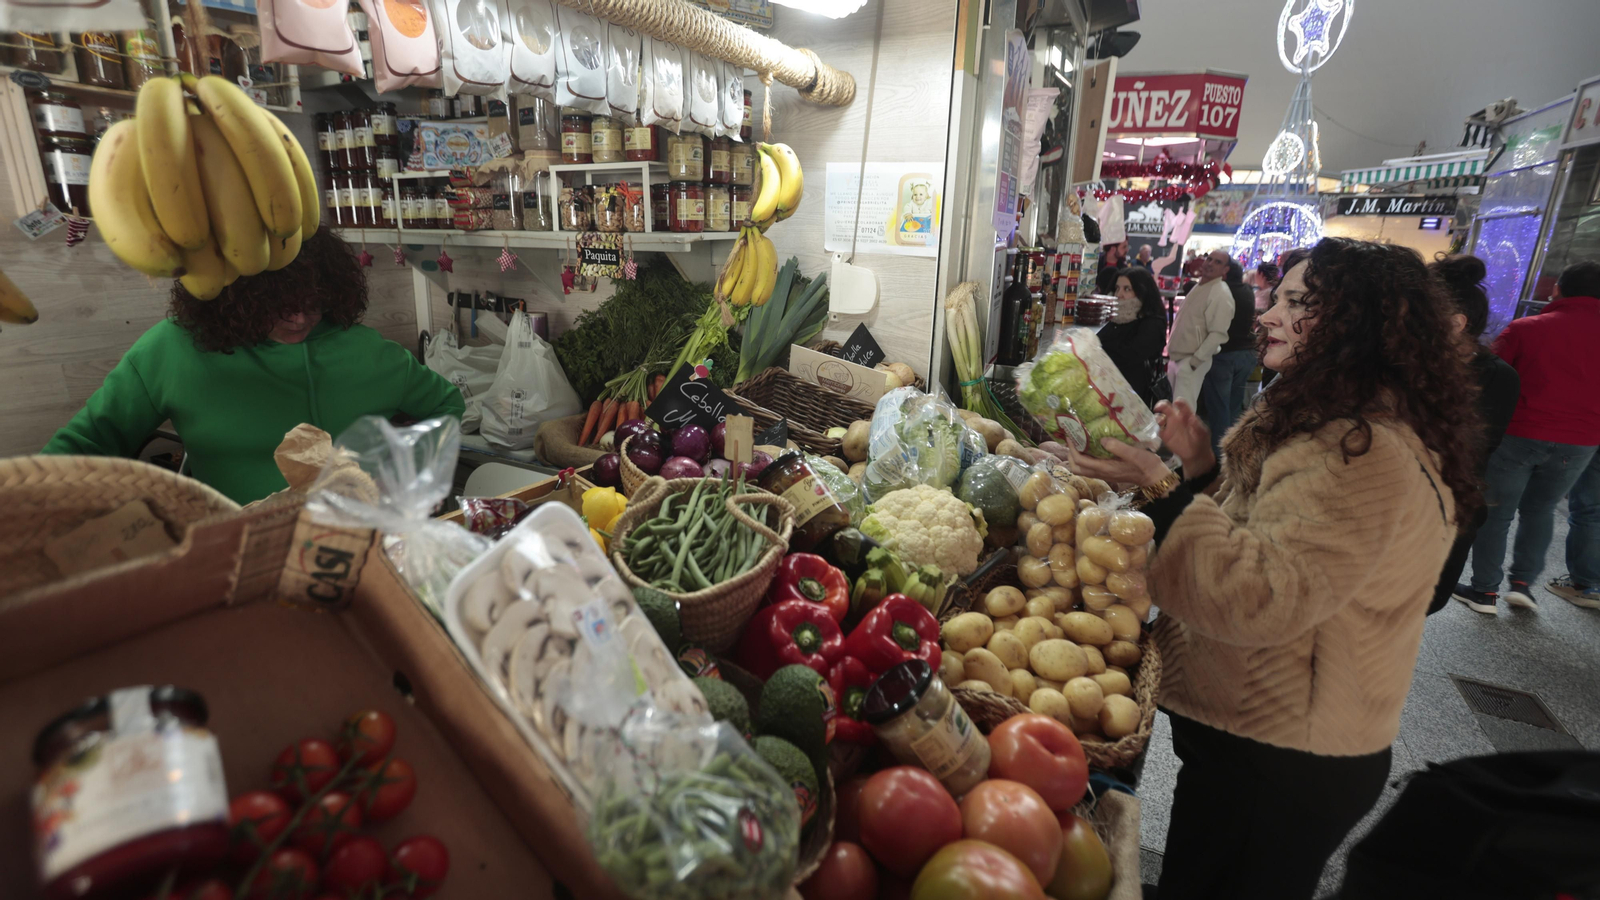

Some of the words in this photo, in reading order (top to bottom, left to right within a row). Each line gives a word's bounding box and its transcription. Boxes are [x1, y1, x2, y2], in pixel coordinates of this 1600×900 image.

[1202, 82, 1241, 106] PUESTO
[1199, 103, 1238, 129] 107
[1345, 198, 1381, 215] J.M.
[1385, 198, 1445, 214] Martín
[1142, 223, 1165, 232] SANT
[584, 249, 617, 263] Paquita
[680, 381, 726, 423] Cebolla
[306, 545, 355, 604] CASI
